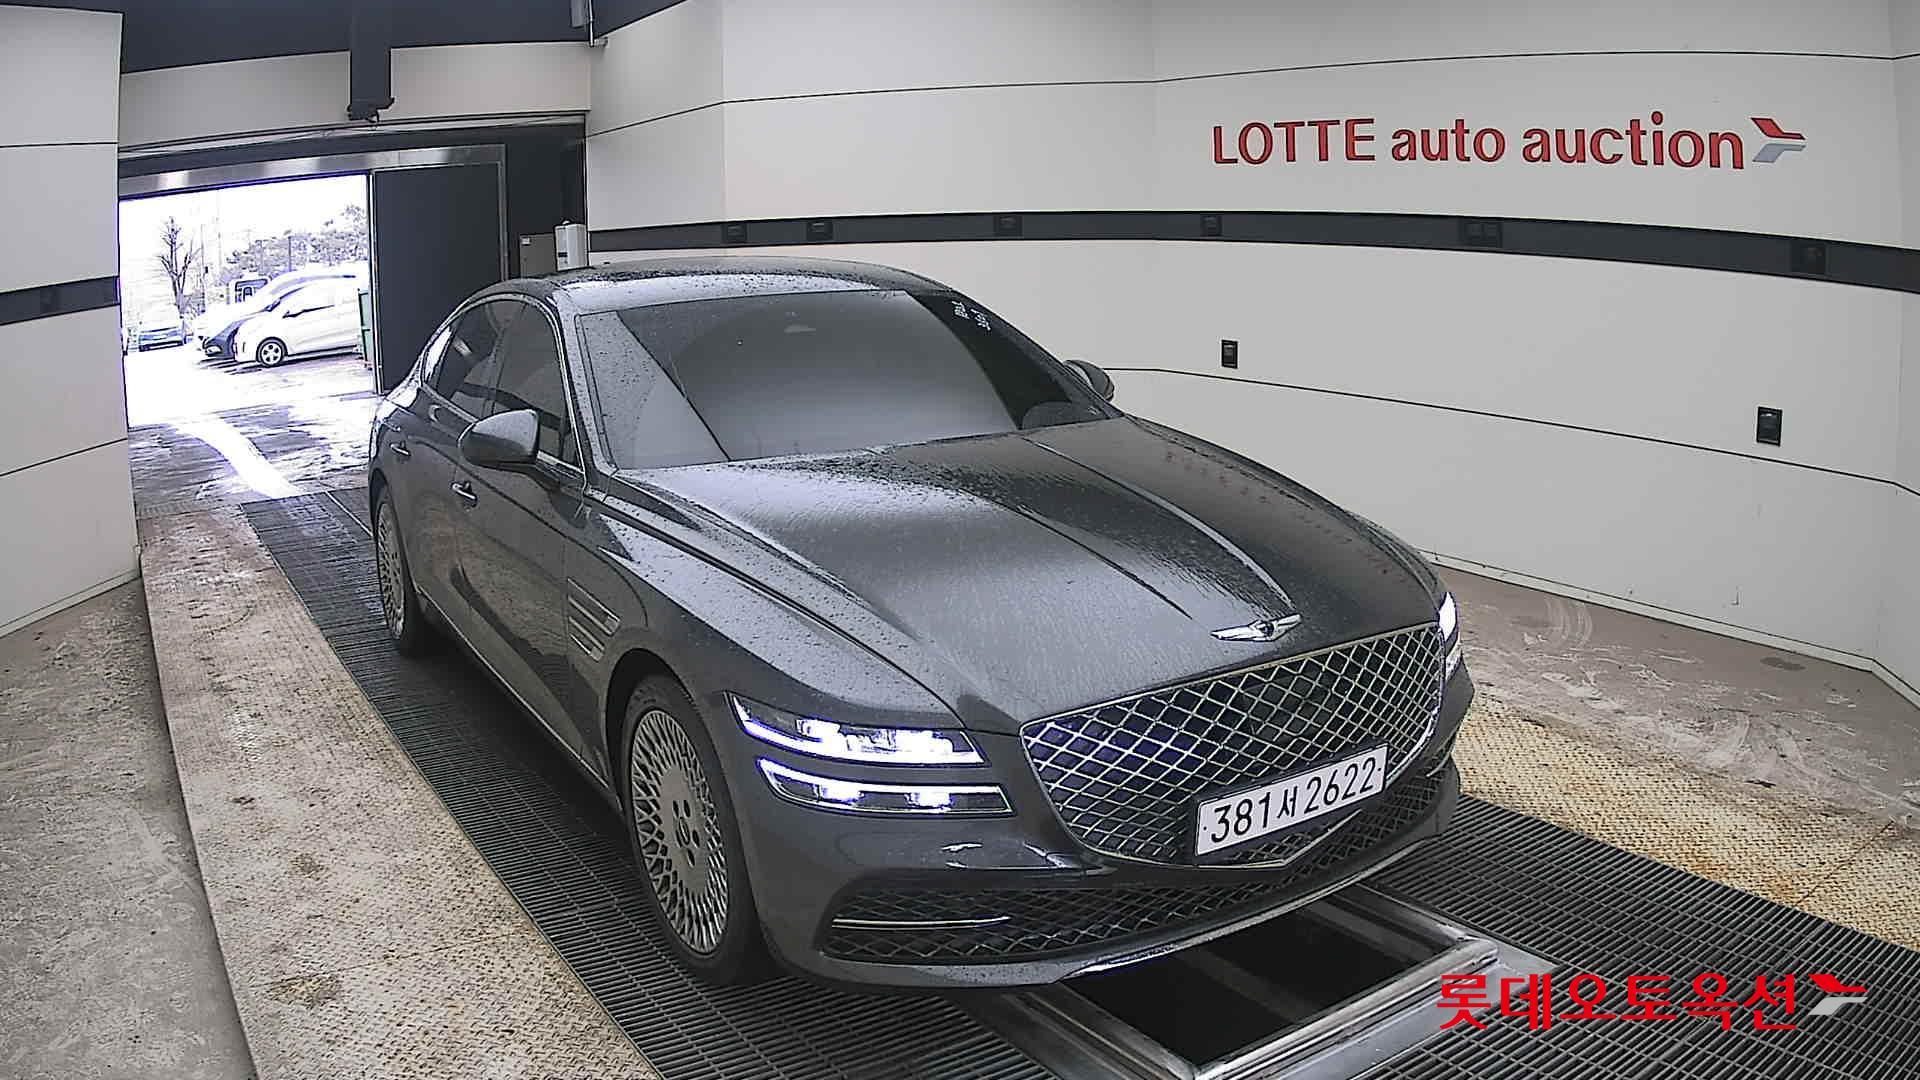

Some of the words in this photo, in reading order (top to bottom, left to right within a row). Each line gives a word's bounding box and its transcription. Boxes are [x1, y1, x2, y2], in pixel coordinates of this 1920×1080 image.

[1212, 118, 1375, 164] LOTTE
[1391, 118, 1506, 163] auto
[1522, 111, 1745, 169] auction
